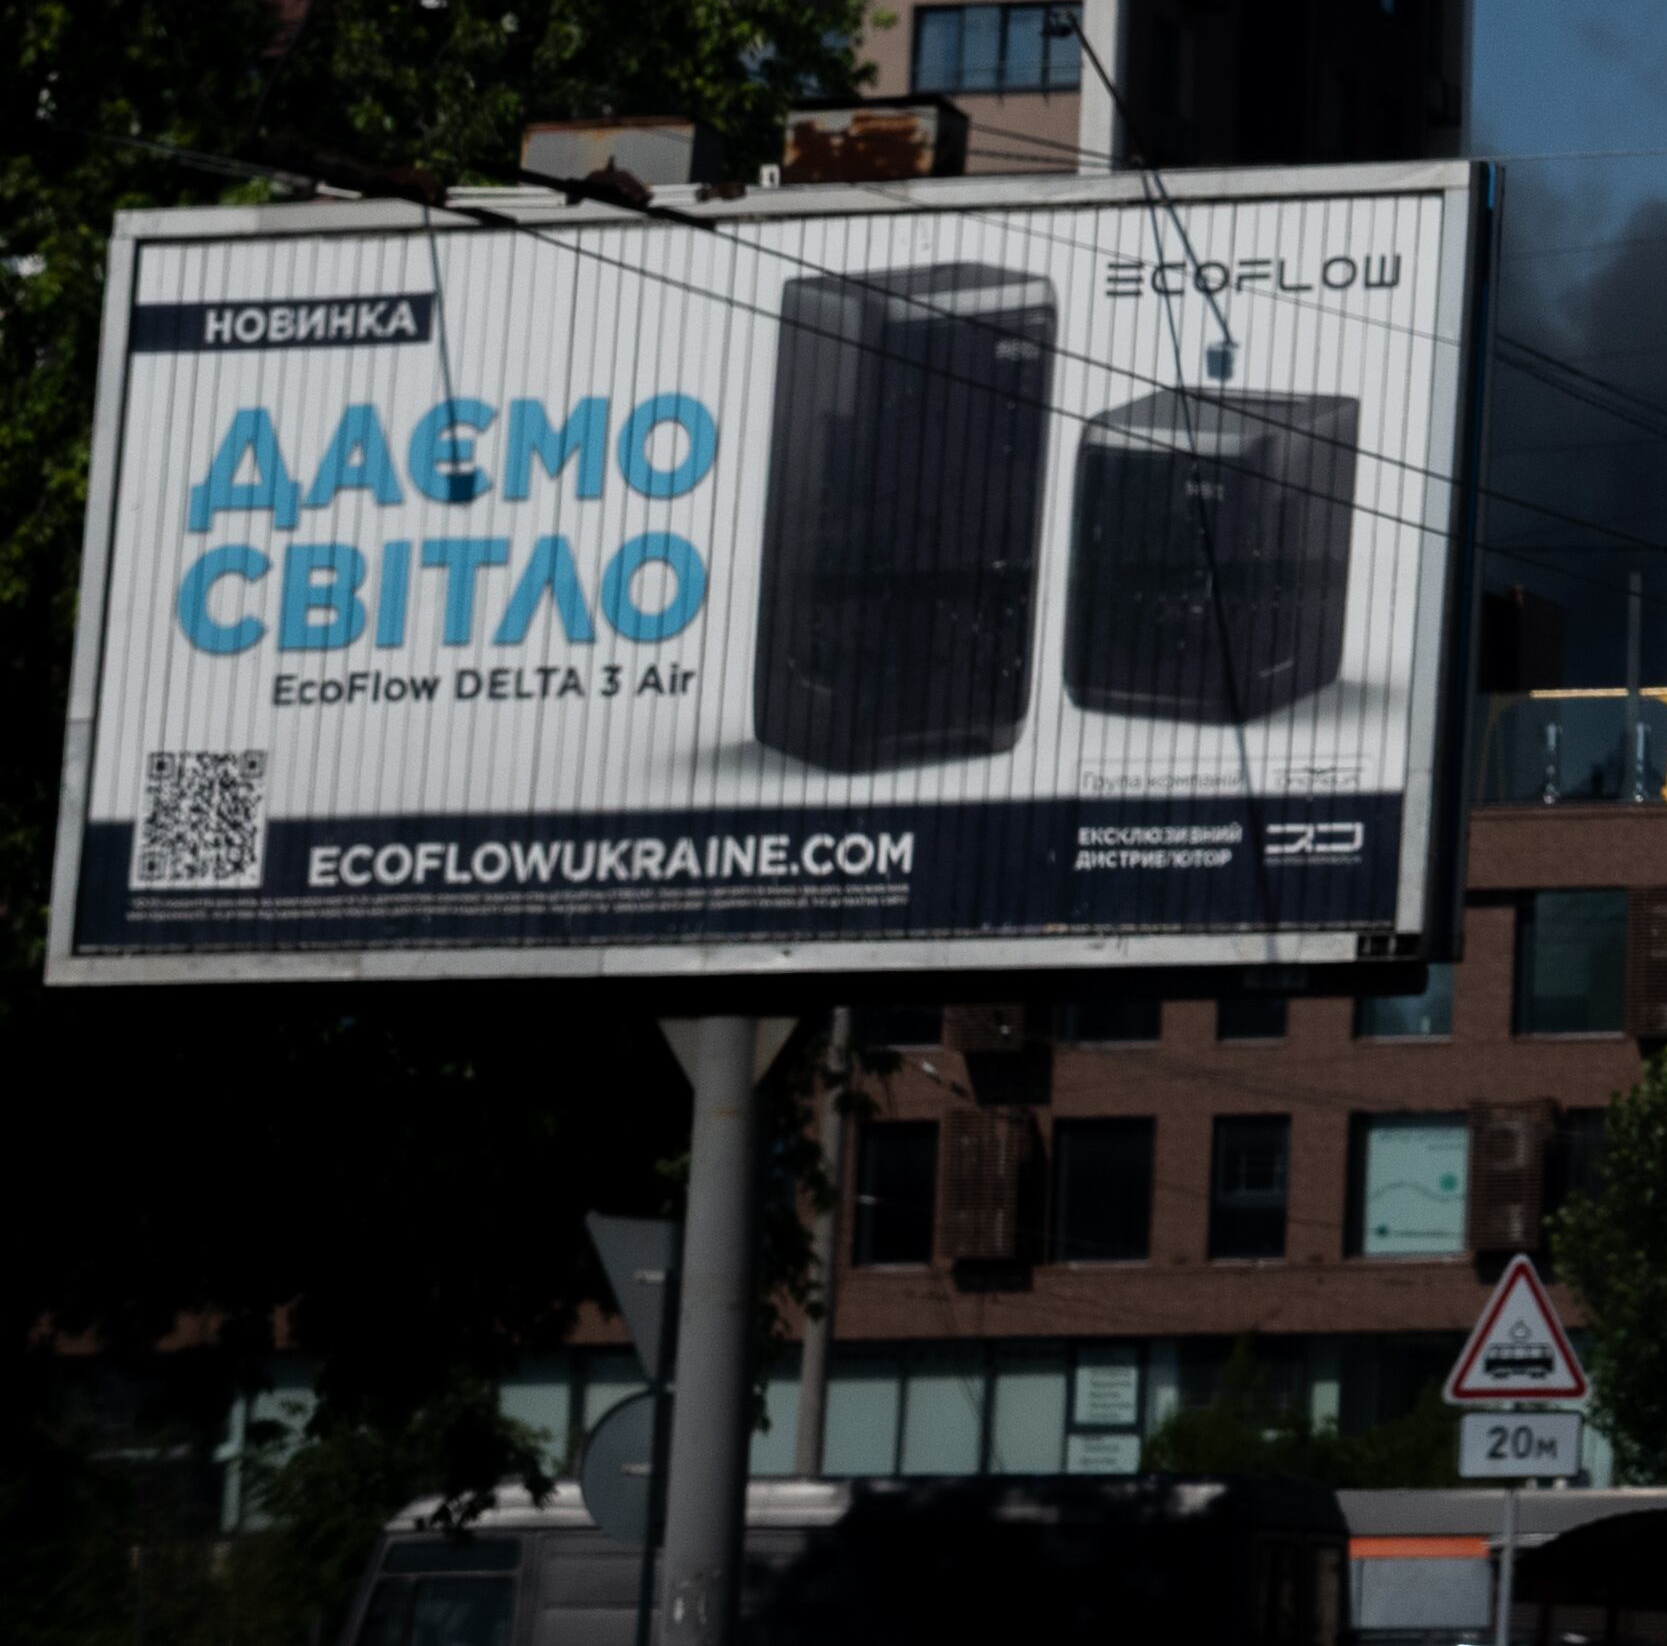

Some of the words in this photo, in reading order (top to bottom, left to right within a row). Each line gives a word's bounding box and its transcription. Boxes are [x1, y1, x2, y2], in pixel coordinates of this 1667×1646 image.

[1106, 254, 1402, 297] ECOFLOW
[204, 301, 418, 345] НОВИНКА
[188, 392, 718, 534] ДАЄМО
[177, 531, 708, 656] СВІТЛО
[273, 672, 441, 707] EcoFlow
[456, 667, 586, 700] DELTA
[602, 666, 621, 698] 3
[637, 664, 697, 697] Air
[1077, 821, 1243, 847] ЕКСКЛЮЗИВНИЙ
[307, 831, 915, 888] ECOFLOWUKRAINE.COM
